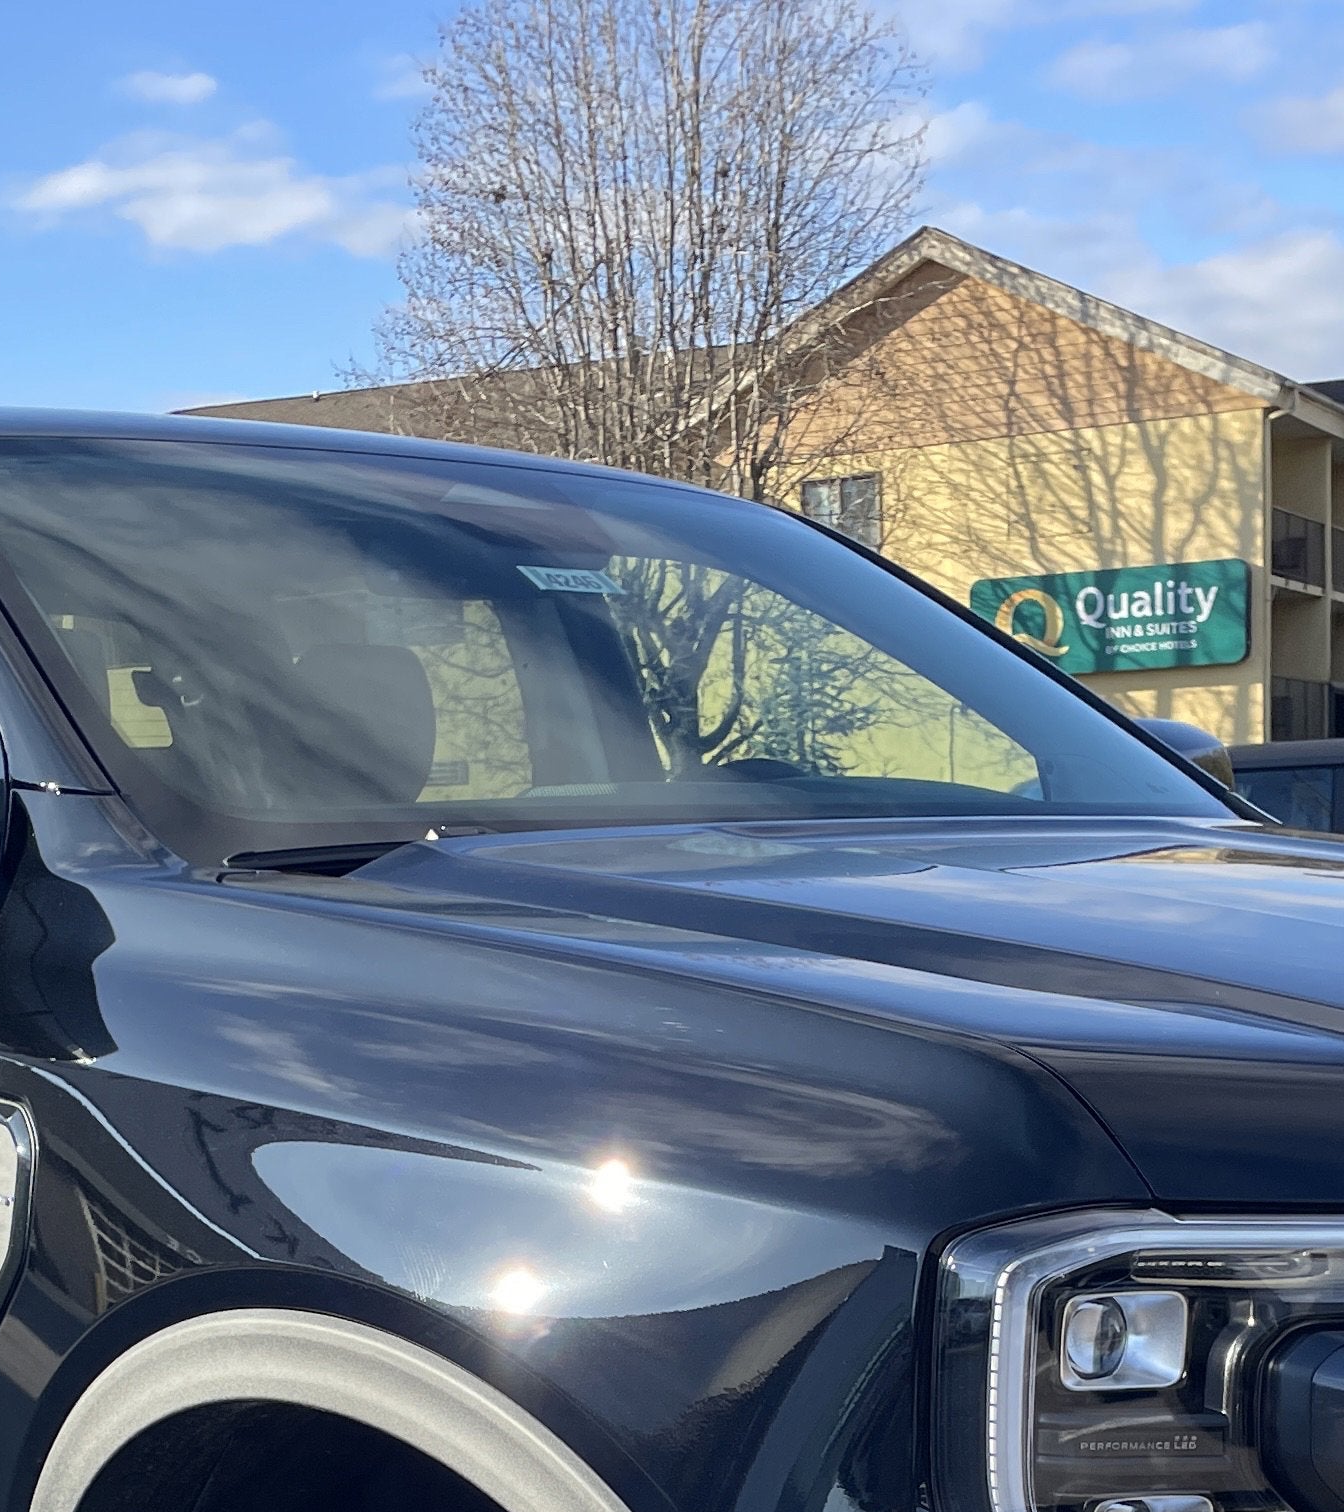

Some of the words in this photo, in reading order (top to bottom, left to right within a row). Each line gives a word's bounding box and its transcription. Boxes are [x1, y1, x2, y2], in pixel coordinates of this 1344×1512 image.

[1076, 580, 1218, 628] Quality
[1106, 625, 1132, 639] INN
[1133, 624, 1144, 637] &
[1146, 620, 1197, 636] SUITES
[1080, 1441, 1170, 1450] PERFORMANCE
[1174, 1440, 1197, 1450] LED
